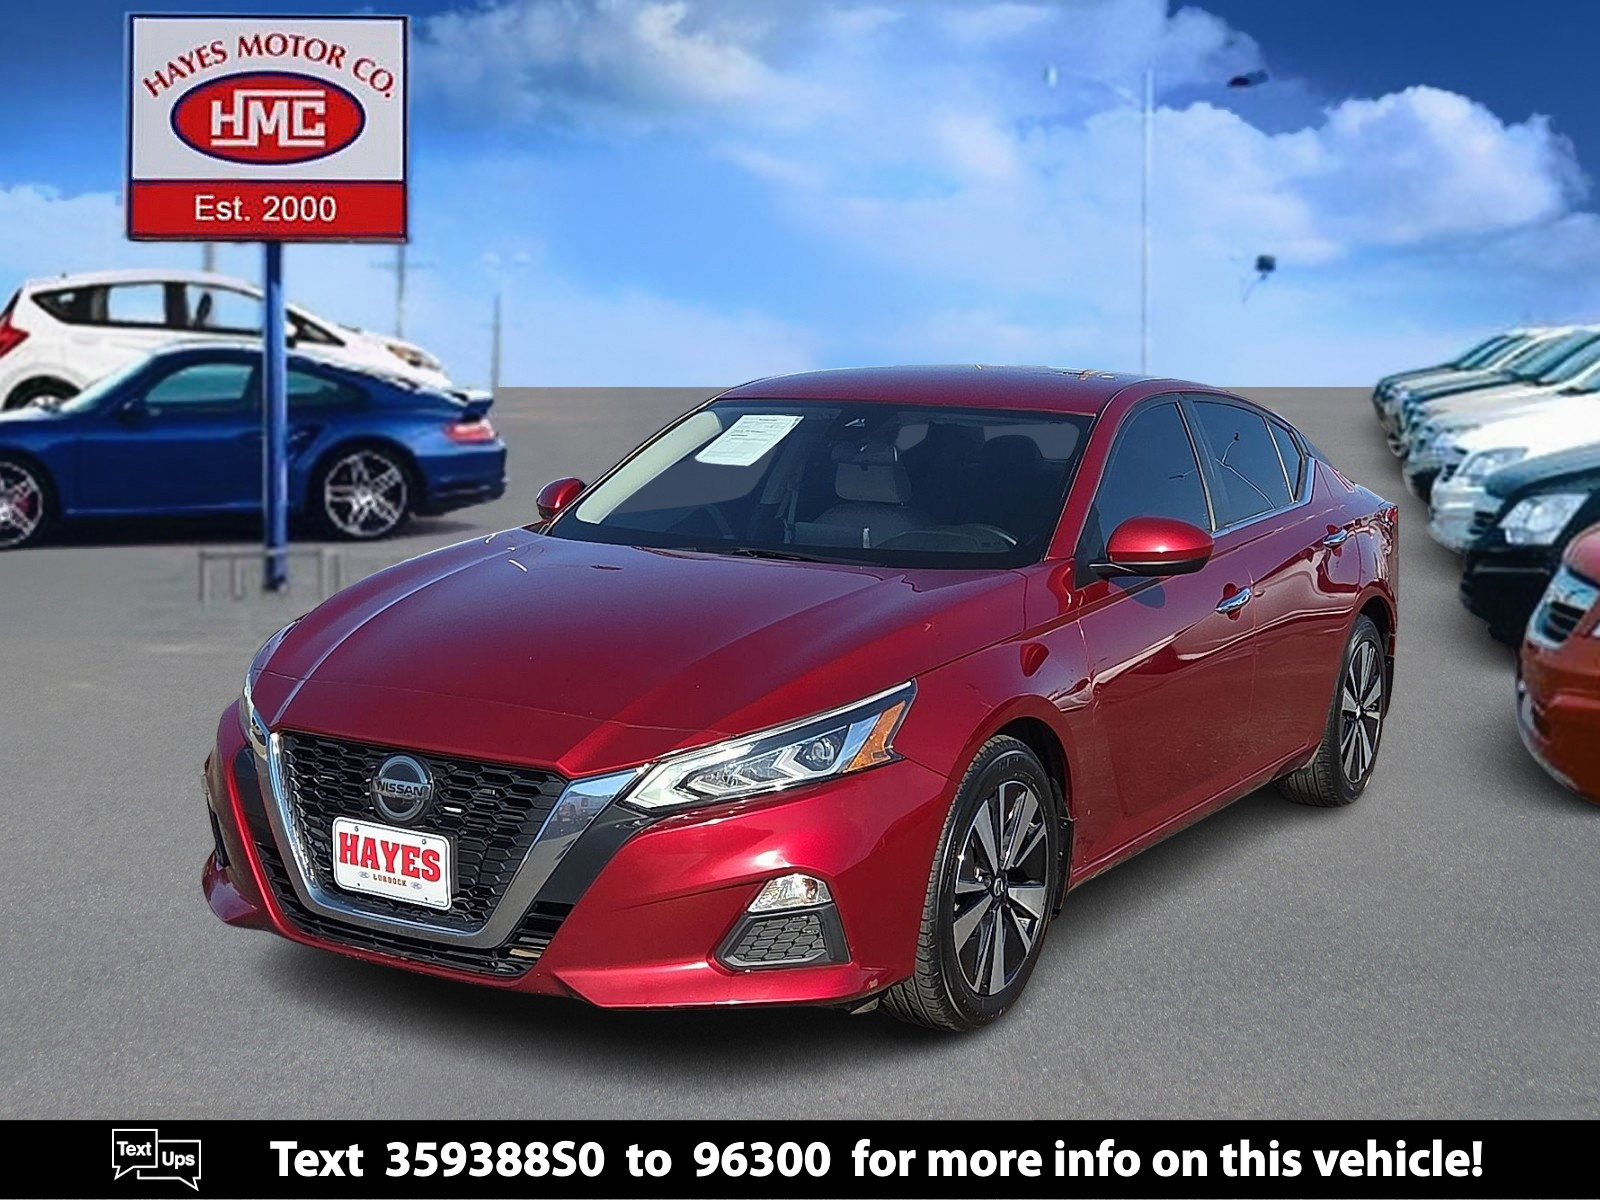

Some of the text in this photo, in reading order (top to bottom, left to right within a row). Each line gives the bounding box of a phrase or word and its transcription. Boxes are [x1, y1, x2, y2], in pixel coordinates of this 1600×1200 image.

[142, 33, 395, 98] HAYES MOTOR CO.
[210, 89, 326, 147] HMC
[194, 194, 337, 222] Est. 2000
[376, 780, 424, 797] NISSAN
[338, 831, 441, 883] HAYES
